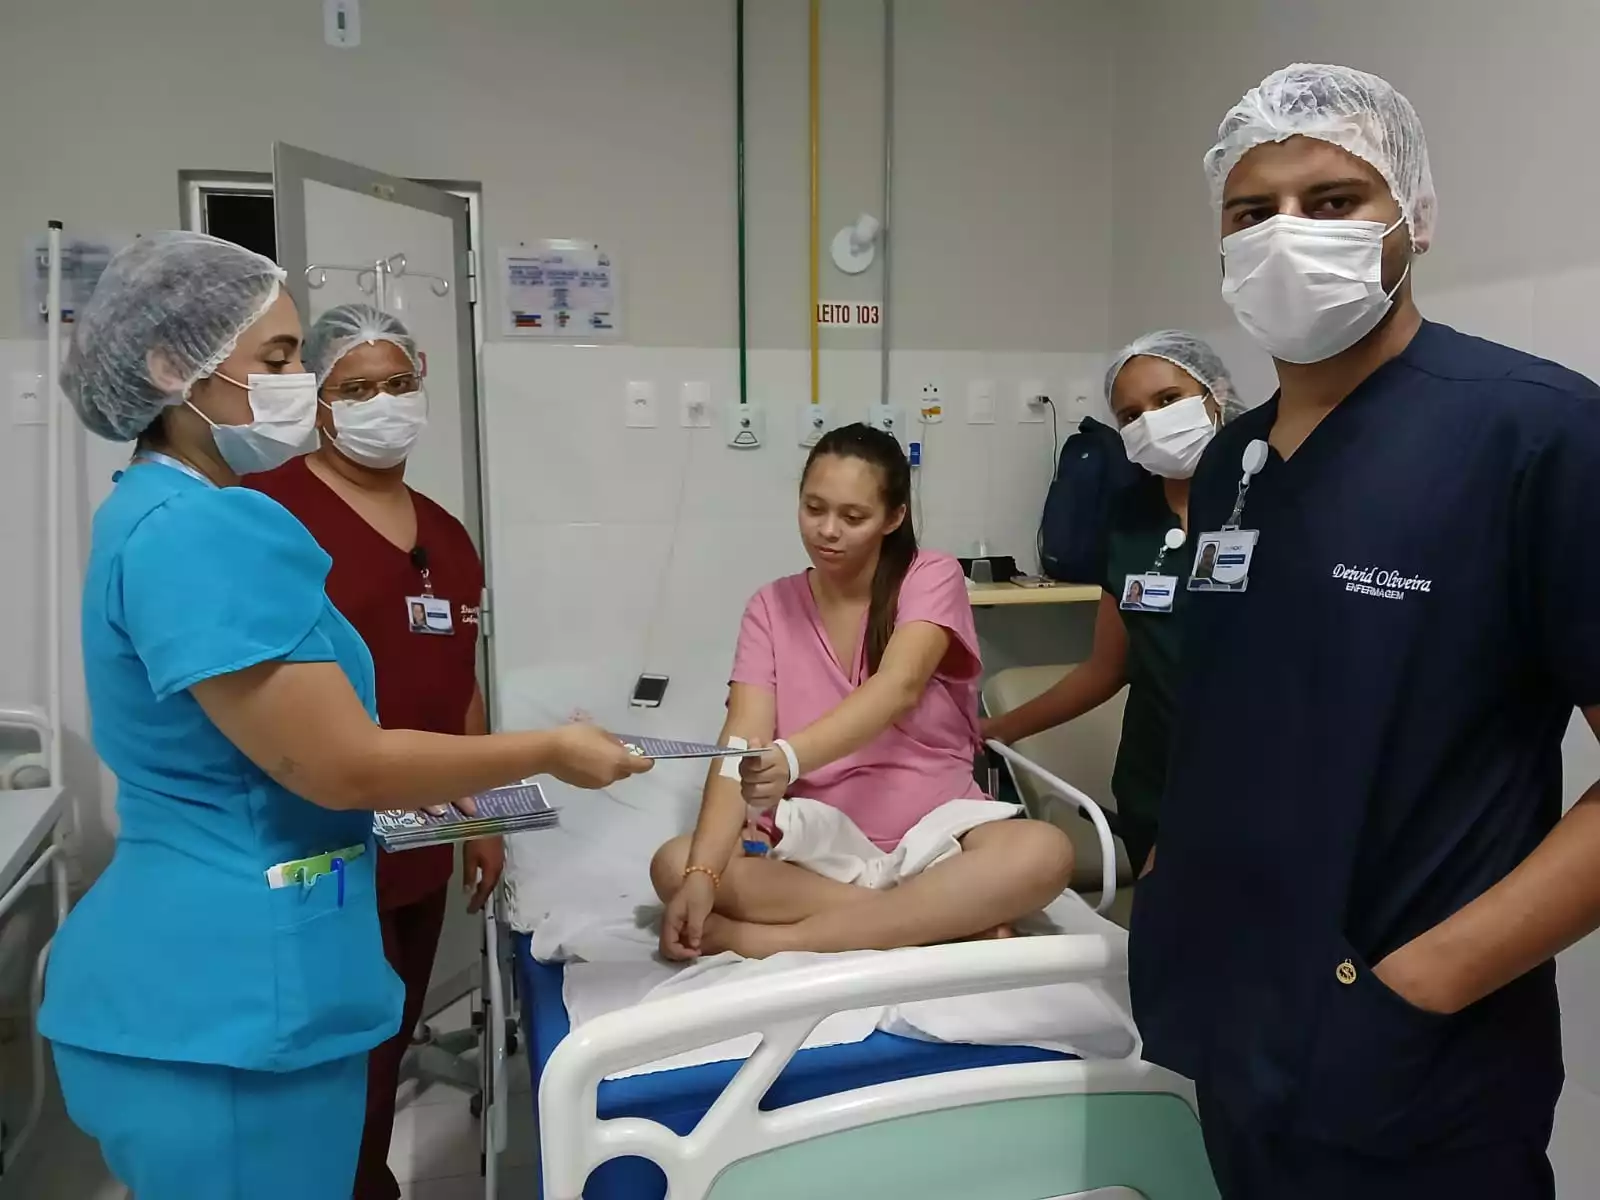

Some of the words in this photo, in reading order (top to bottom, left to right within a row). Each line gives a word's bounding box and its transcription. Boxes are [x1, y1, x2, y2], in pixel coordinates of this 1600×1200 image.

[816, 304, 850, 323] LEITO
[856, 305, 879, 324] 103
[1333, 563, 1378, 582] Deivid
[1376, 570, 1431, 592] Oliveira
[1346, 583, 1404, 600] ENFERMAGEM
